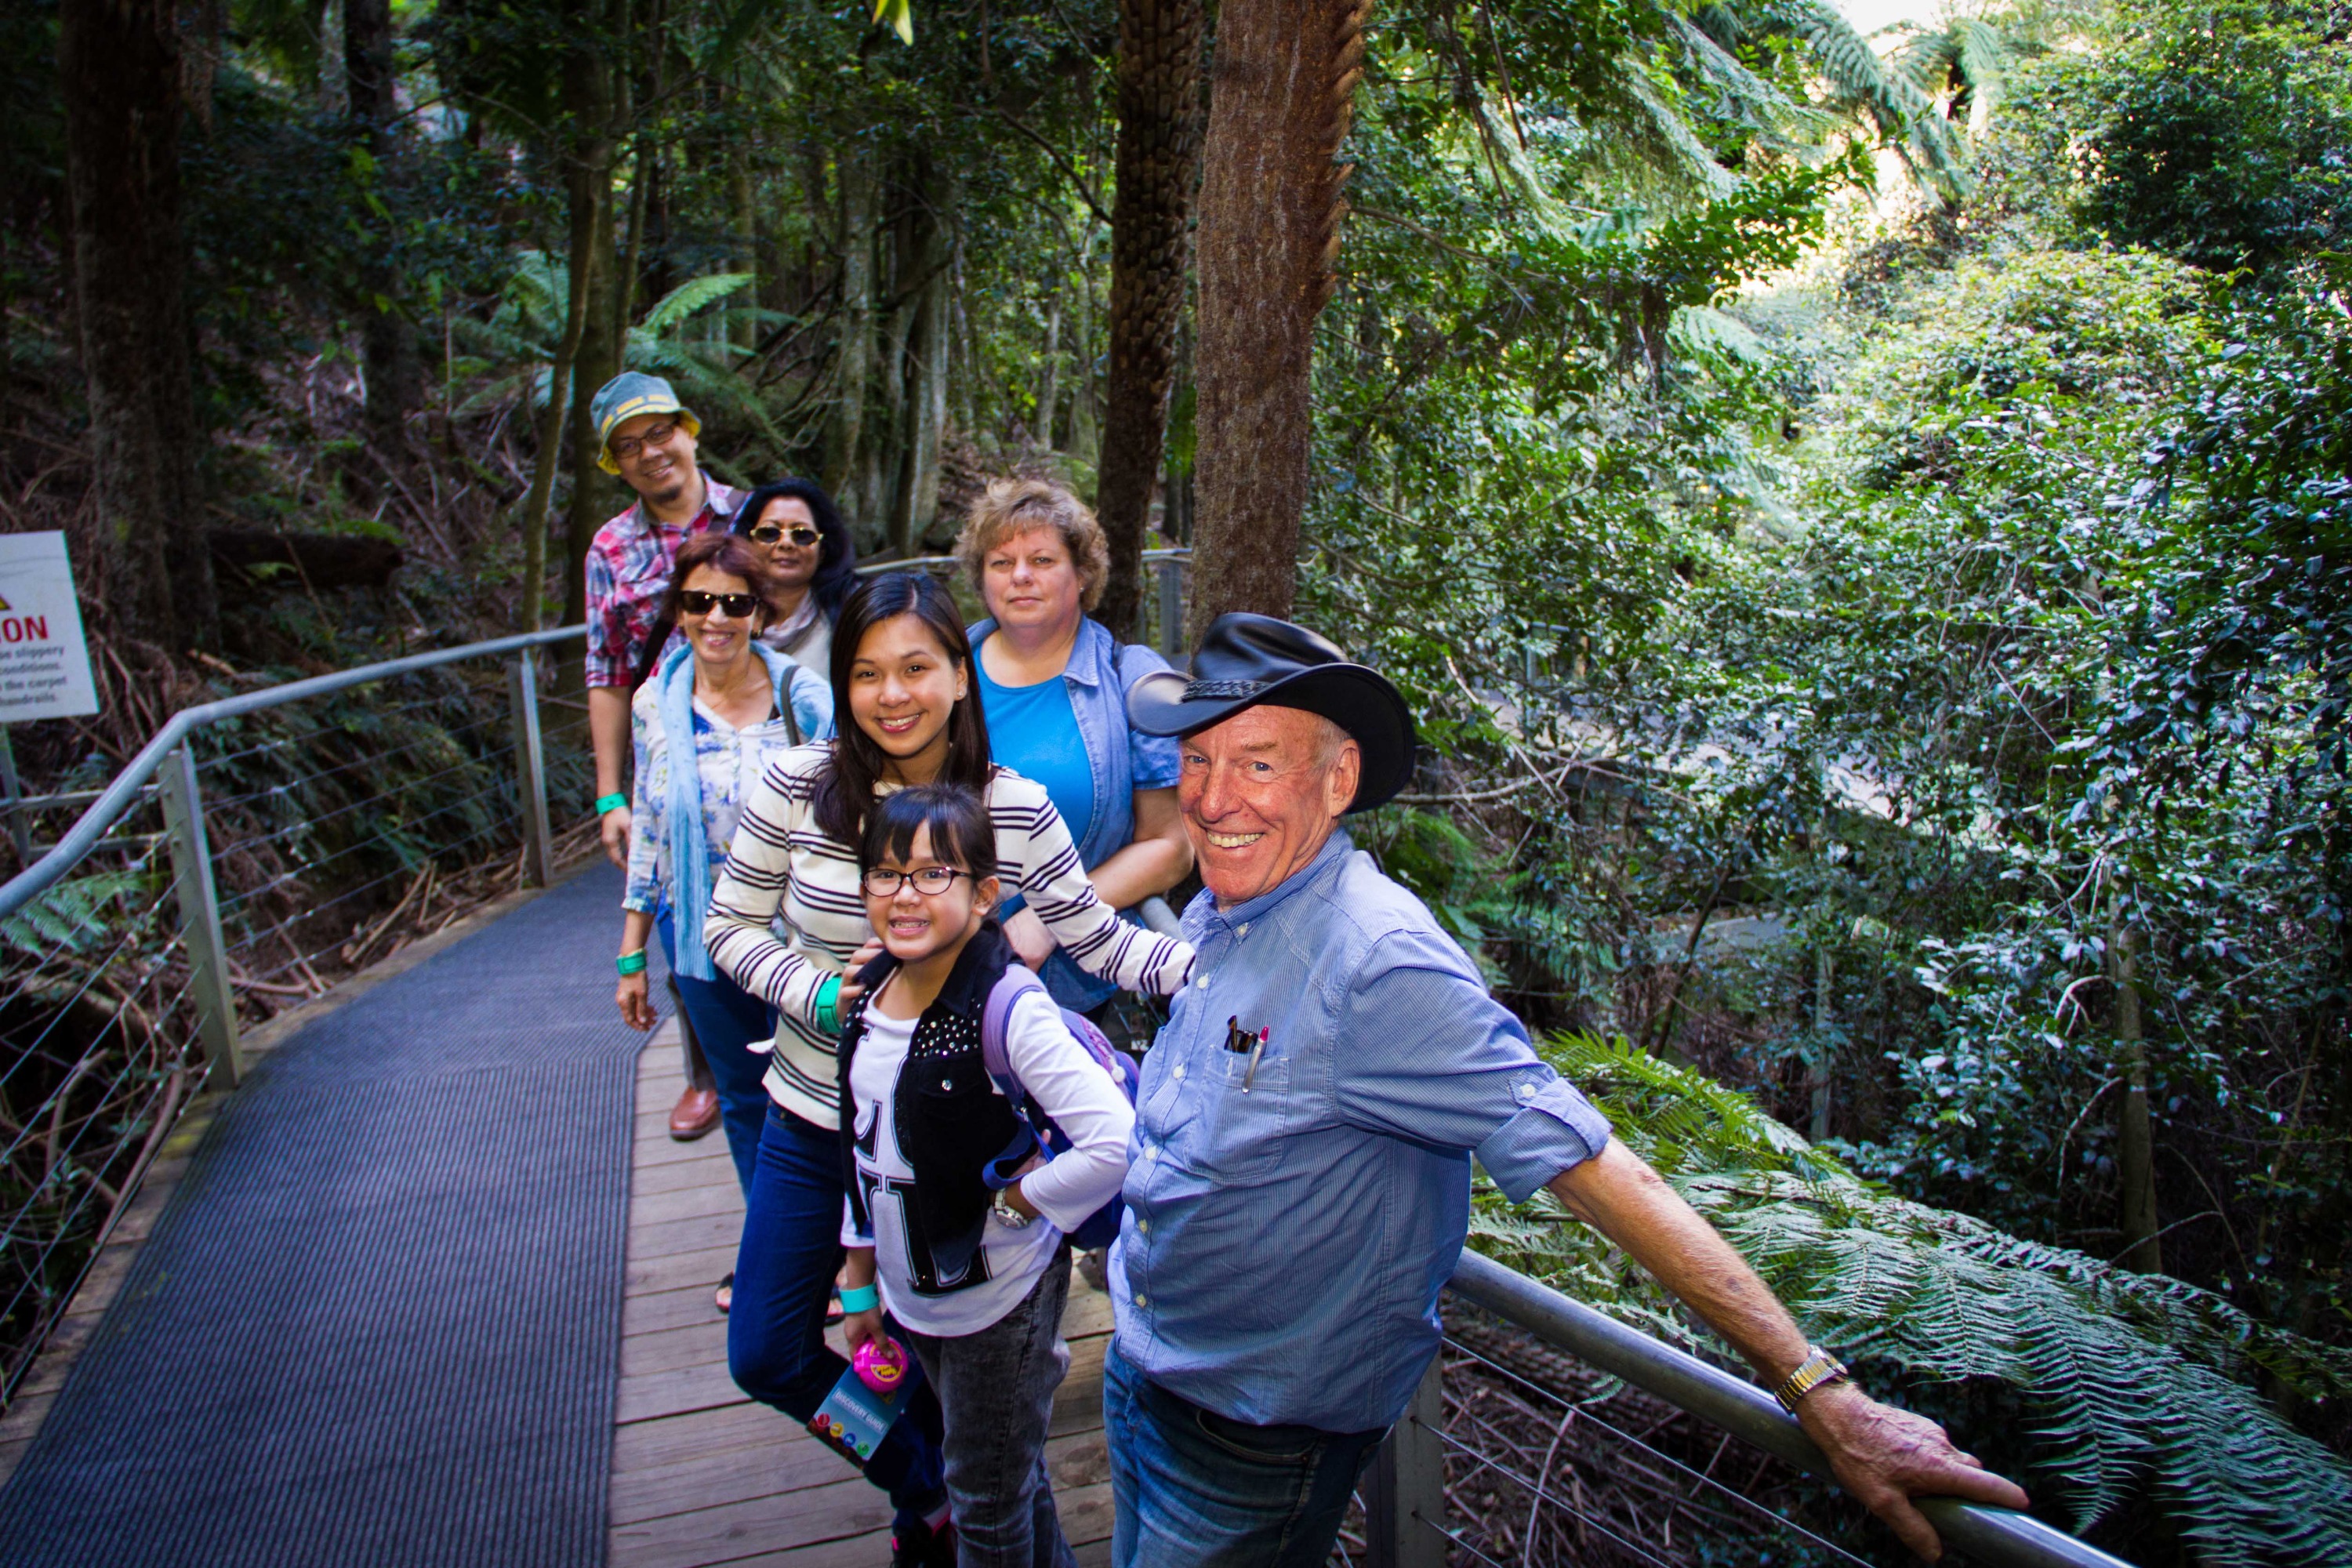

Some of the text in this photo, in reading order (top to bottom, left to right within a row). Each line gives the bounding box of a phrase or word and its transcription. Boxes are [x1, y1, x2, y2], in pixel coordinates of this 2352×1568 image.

[0, 615, 49, 643] ON
[15, 645, 64, 659] slippery
[835, 1390, 885, 1431] DISCOVERY GUIDE
